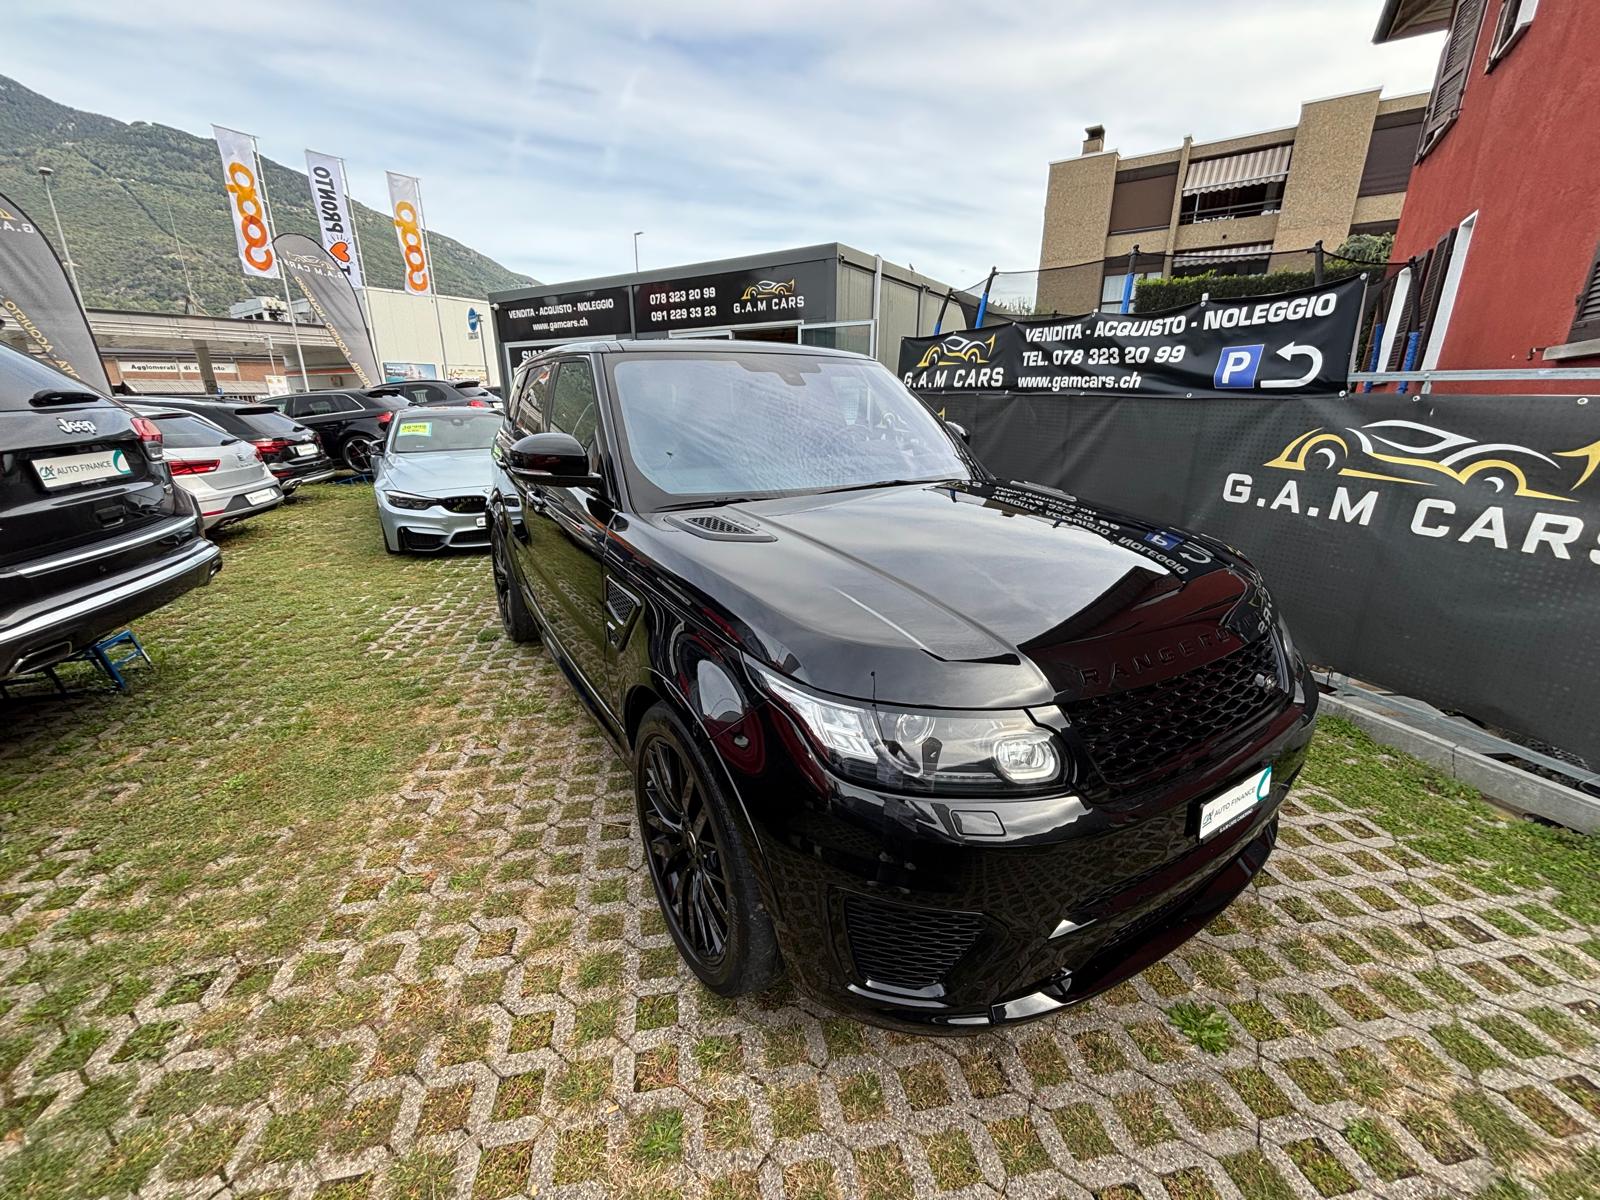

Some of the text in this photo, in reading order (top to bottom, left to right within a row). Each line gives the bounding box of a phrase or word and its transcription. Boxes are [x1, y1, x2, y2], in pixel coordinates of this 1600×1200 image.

[650, 287, 716, 305] 078 323 20 99
[733, 296, 805, 314] G.A.M CARS
[508, 308, 535, 319] VENDITA
[539, 303, 572, 316] ACQUISTO
[577, 298, 614, 312] NOLEGGIO
[651, 305, 717, 321] 091 229 33 23
[1025, 324, 1082, 343] VENDITA
[1094, 315, 1186, 338] ACQUISTO
[1203, 293, 1337, 331] NOLEGGIO
[532, 317, 588, 332] www.gamcars.ch
[1022, 345, 1186, 366] TEL. 078 323 20 99
[131, 363, 176, 372] Agglomerati
[904, 367, 1004, 388] G.A.M CARS
[1221, 351, 1251, 384] P
[1018, 371, 1141, 392] www.gamcars.ch
[57, 418, 97, 435] Jeep
[57, 465, 79, 476] AUTO
[80, 460, 112, 472] FINANCE
[1222, 472, 1600, 566] G.A.M CAR
[1214, 802, 1231, 817] AUTO
[1231, 786, 1256, 807] FINANCE
